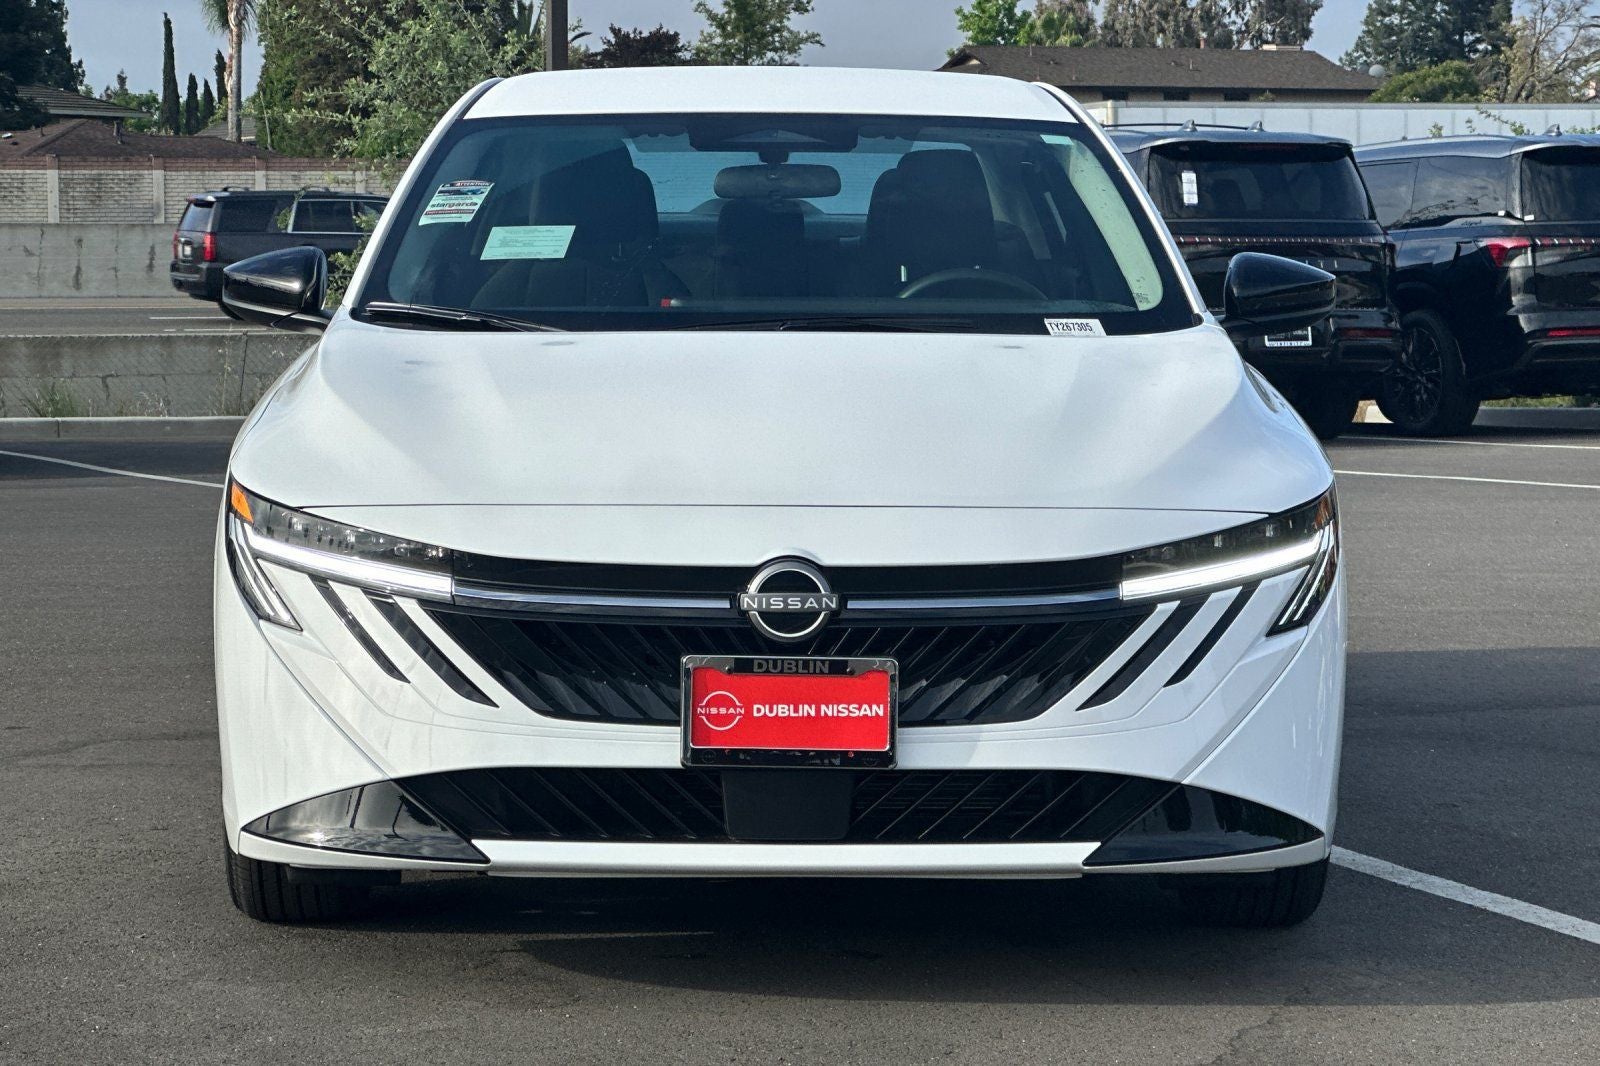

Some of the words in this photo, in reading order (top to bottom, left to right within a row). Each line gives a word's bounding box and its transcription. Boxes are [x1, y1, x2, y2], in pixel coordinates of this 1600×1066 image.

[1046, 322, 1093, 332] TY267305
[743, 597, 837, 609] NISSAN
[753, 659, 829, 674] DUBLIN
[697, 707, 745, 715] NISSAN
[753, 704, 816, 717] DUBLIN
[820, 704, 884, 717] NISSAN
